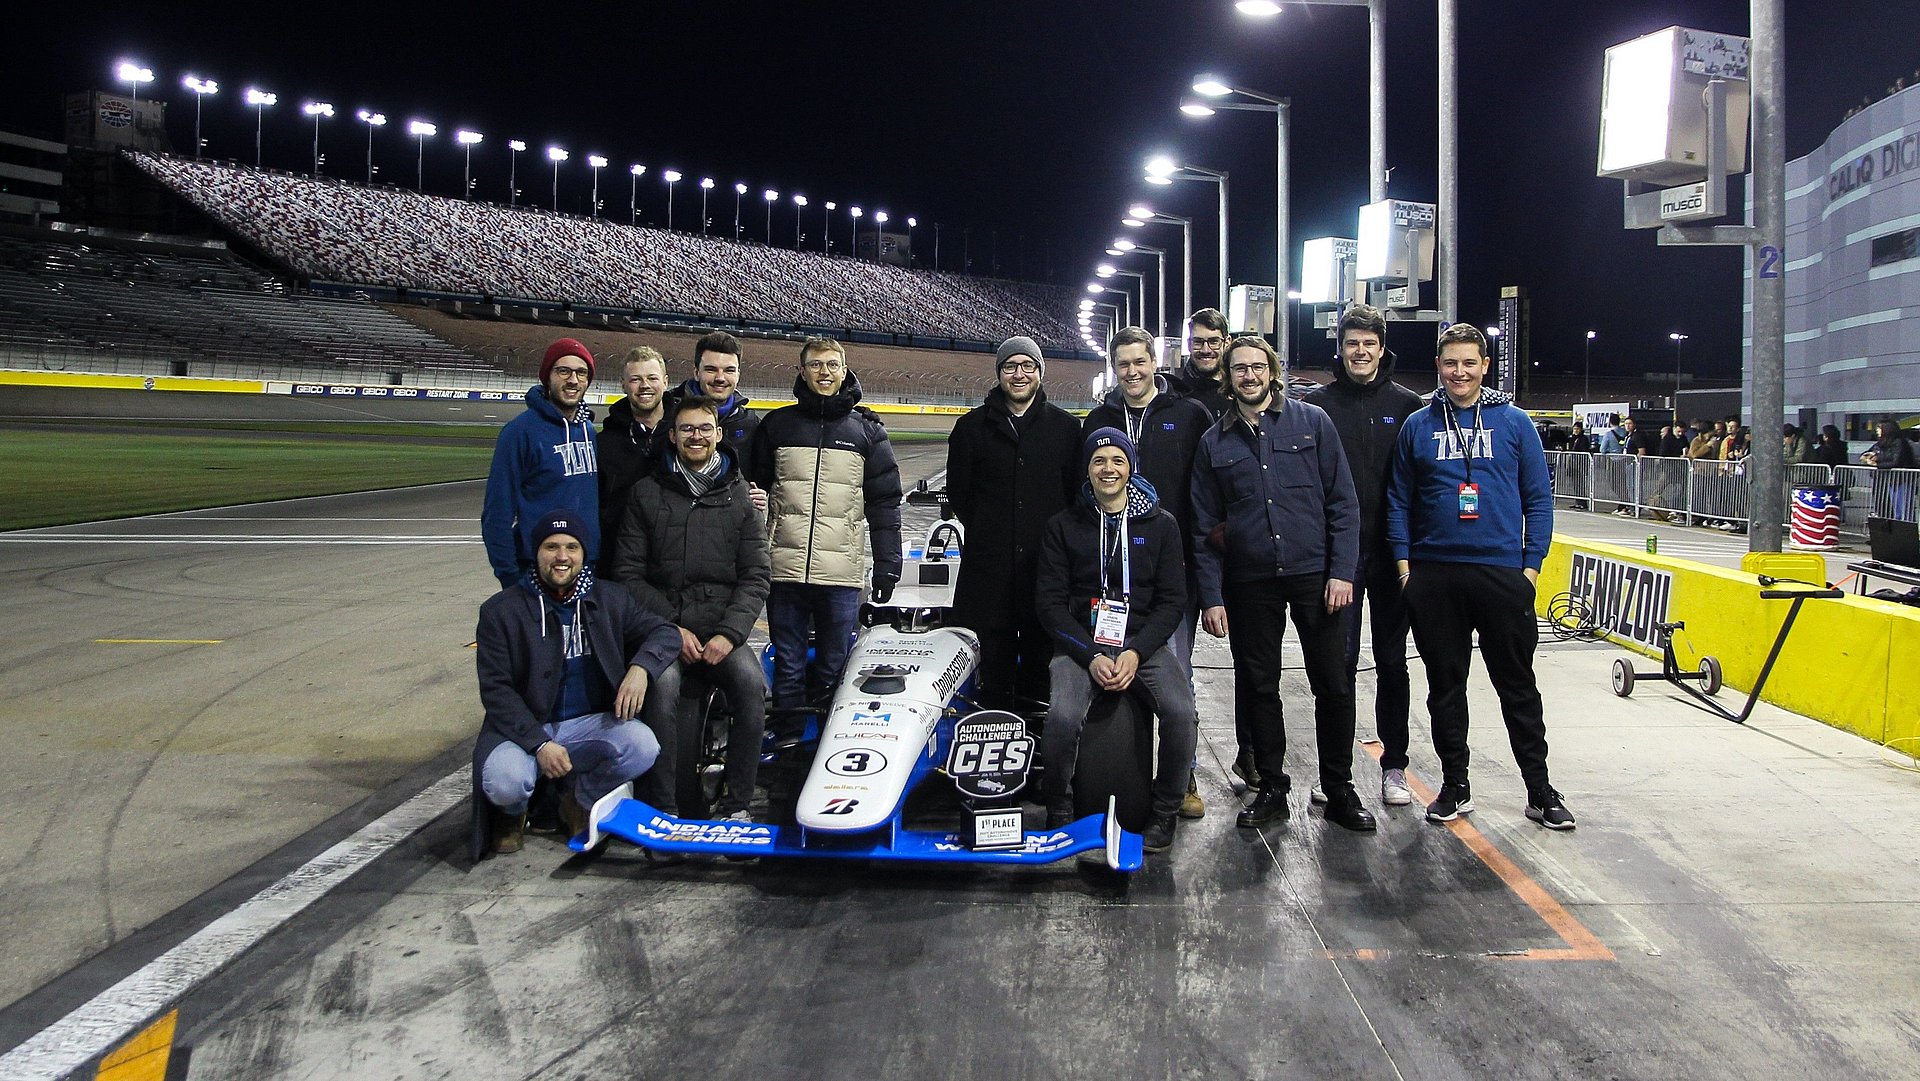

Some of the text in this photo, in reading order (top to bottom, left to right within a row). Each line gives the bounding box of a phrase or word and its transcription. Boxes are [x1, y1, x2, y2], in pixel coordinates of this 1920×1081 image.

[1758, 245, 1778, 279] 2
[296, 386, 526, 401] GEICO GEICO GEICO GEICO RESTART ZONE GEICO GEIC
[1096, 436, 1112, 447] TUM
[552, 520, 568, 529] TUM
[931, 646, 971, 703] BRIDGESTONE
[958, 722, 1022, 734] AUTONOMOUS
[959, 731, 1013, 743] CHALLENGE
[841, 752, 871, 772] 3
[953, 740, 1028, 773] CES
[650, 816, 771, 835] INDIANA
[992, 817, 1016, 829] PLACE
[638, 823, 772, 845] WINNERS
